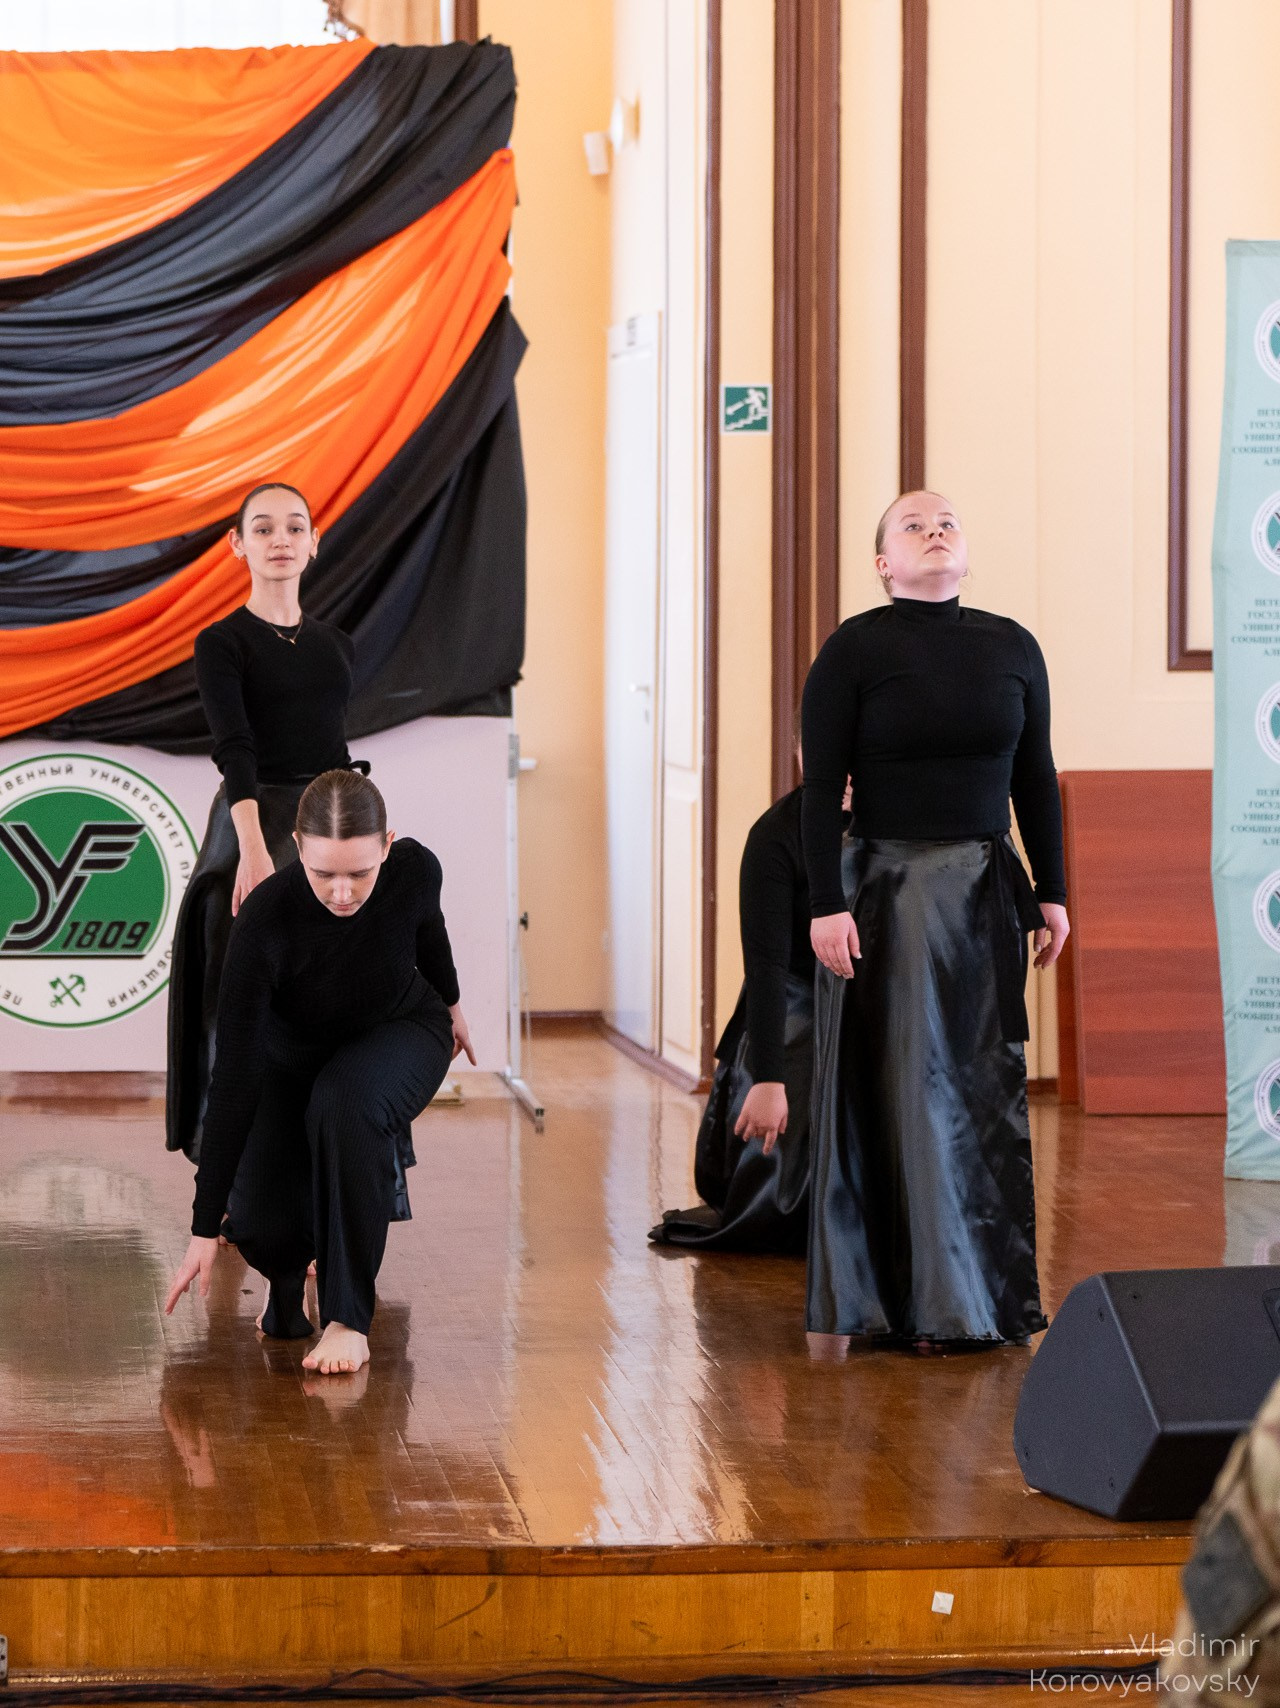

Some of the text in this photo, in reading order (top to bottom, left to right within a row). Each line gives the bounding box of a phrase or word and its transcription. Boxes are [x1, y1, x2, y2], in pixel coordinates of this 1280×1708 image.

[90, 767, 184, 850] УНИВЕРСИТЕТ
[180, 859, 193, 890] ПУ
[61, 920, 152, 951] 1809
